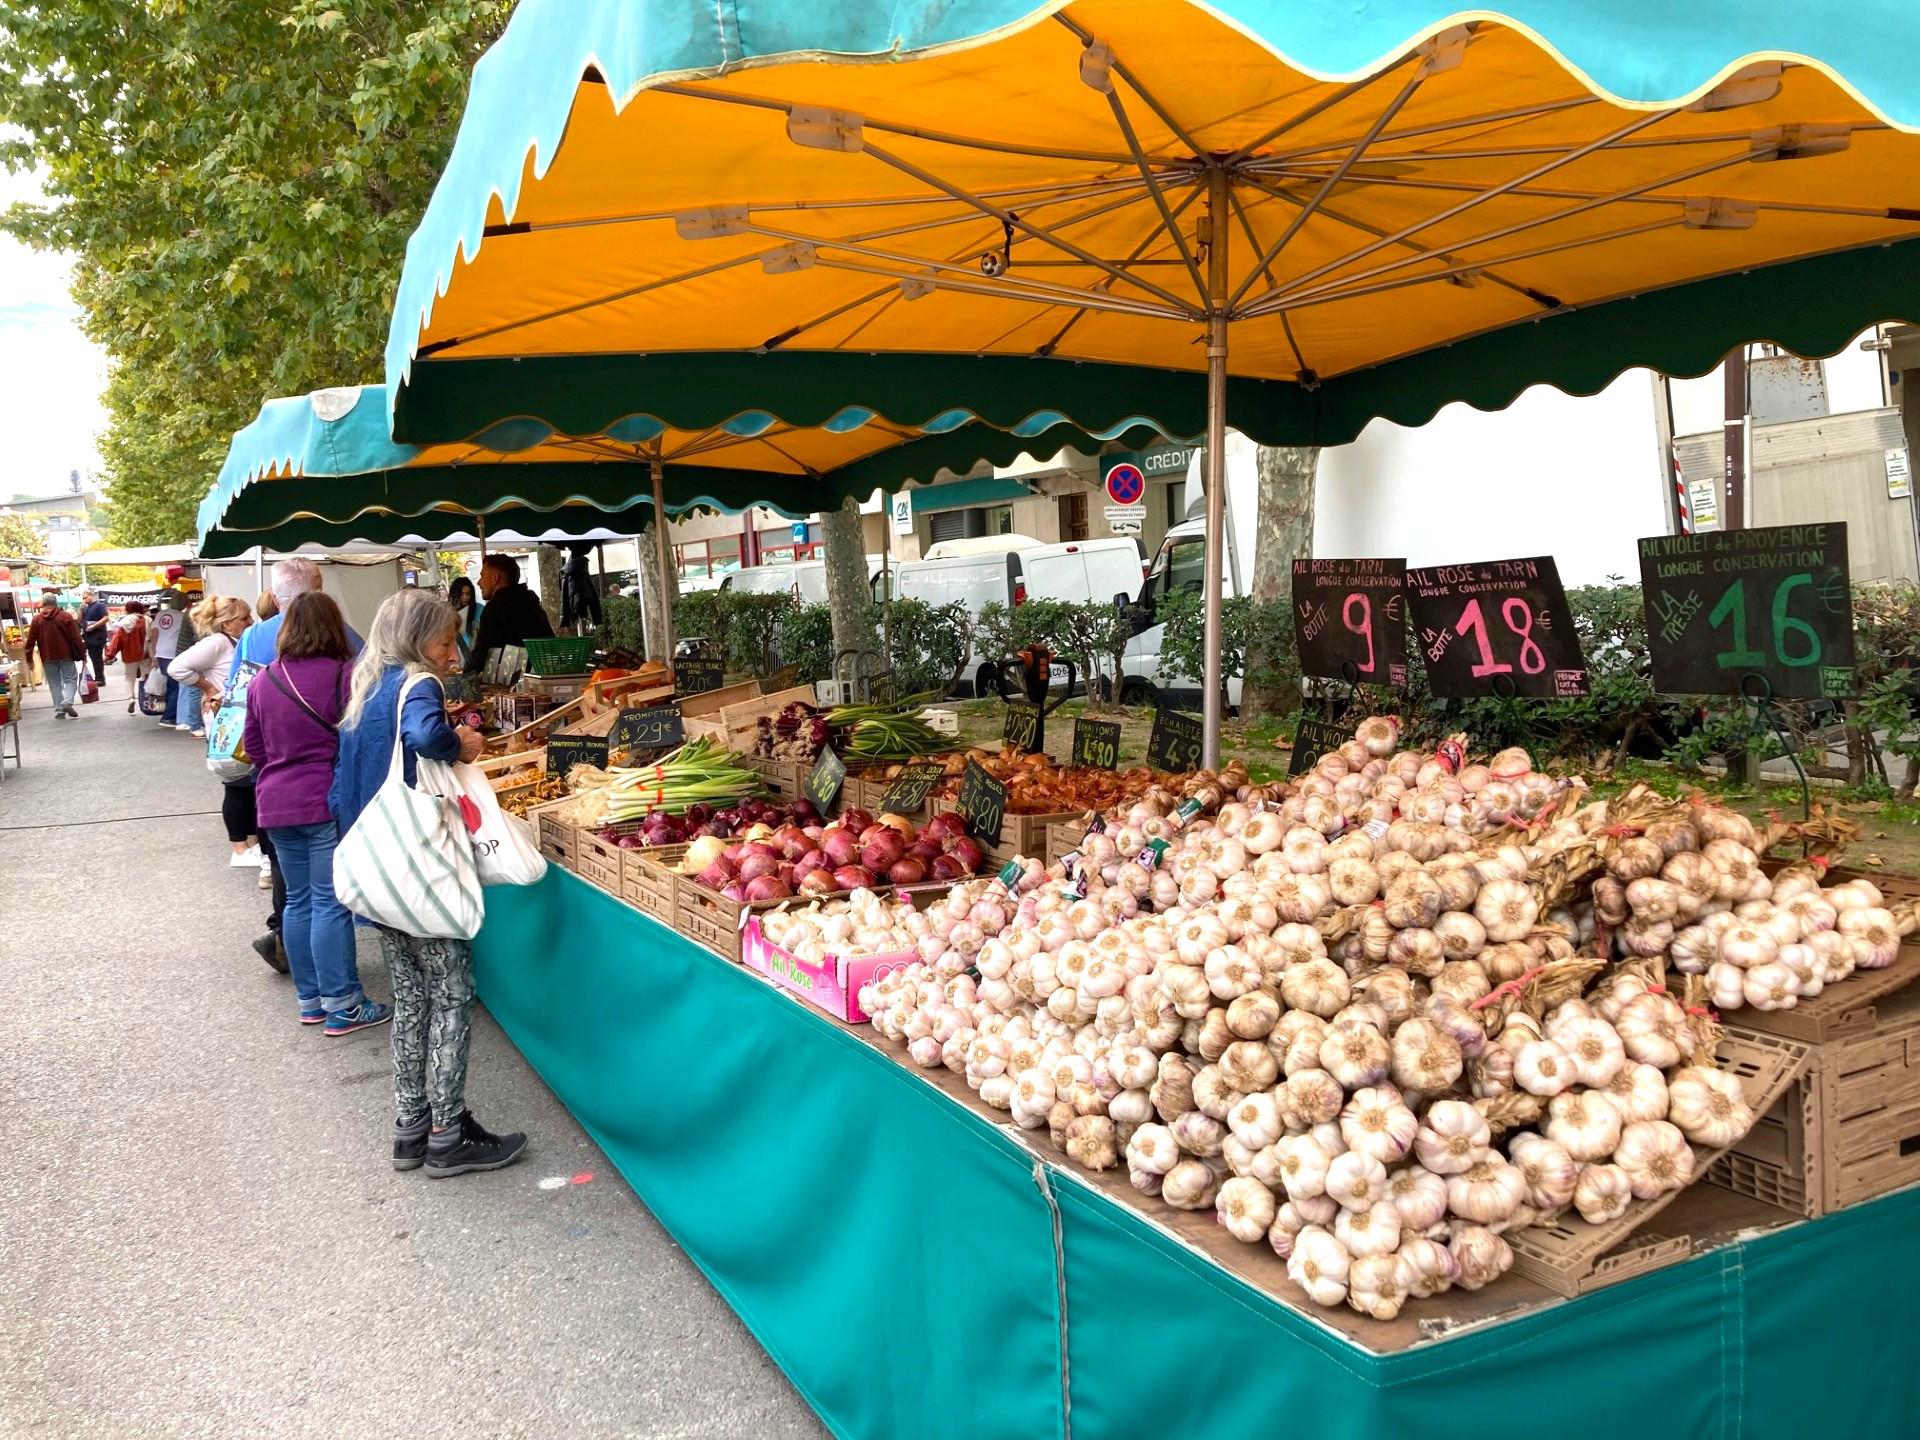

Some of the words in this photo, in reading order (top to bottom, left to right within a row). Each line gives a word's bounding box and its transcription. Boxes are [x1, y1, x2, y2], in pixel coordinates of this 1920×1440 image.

[1663, 534, 1709, 555] VIOLET
[1735, 525, 1827, 549] PROVENCE
[1312, 560, 1335, 574] ROSE
[1354, 560, 1383, 574] TARN
[1437, 565, 1475, 584] ROSE
[1494, 561, 1538, 578] TARN
[1713, 550, 1825, 573] CONSERVATION
[1316, 575, 1342, 586] LONGUE
[1419, 587, 1450, 597] LONGUE
[108, 594, 159, 604] FROMAGERIE
[1304, 602, 1328, 640] BOTTE
[1659, 589, 1704, 645] TRESSE
[1427, 627, 1453, 663] BOTTE
